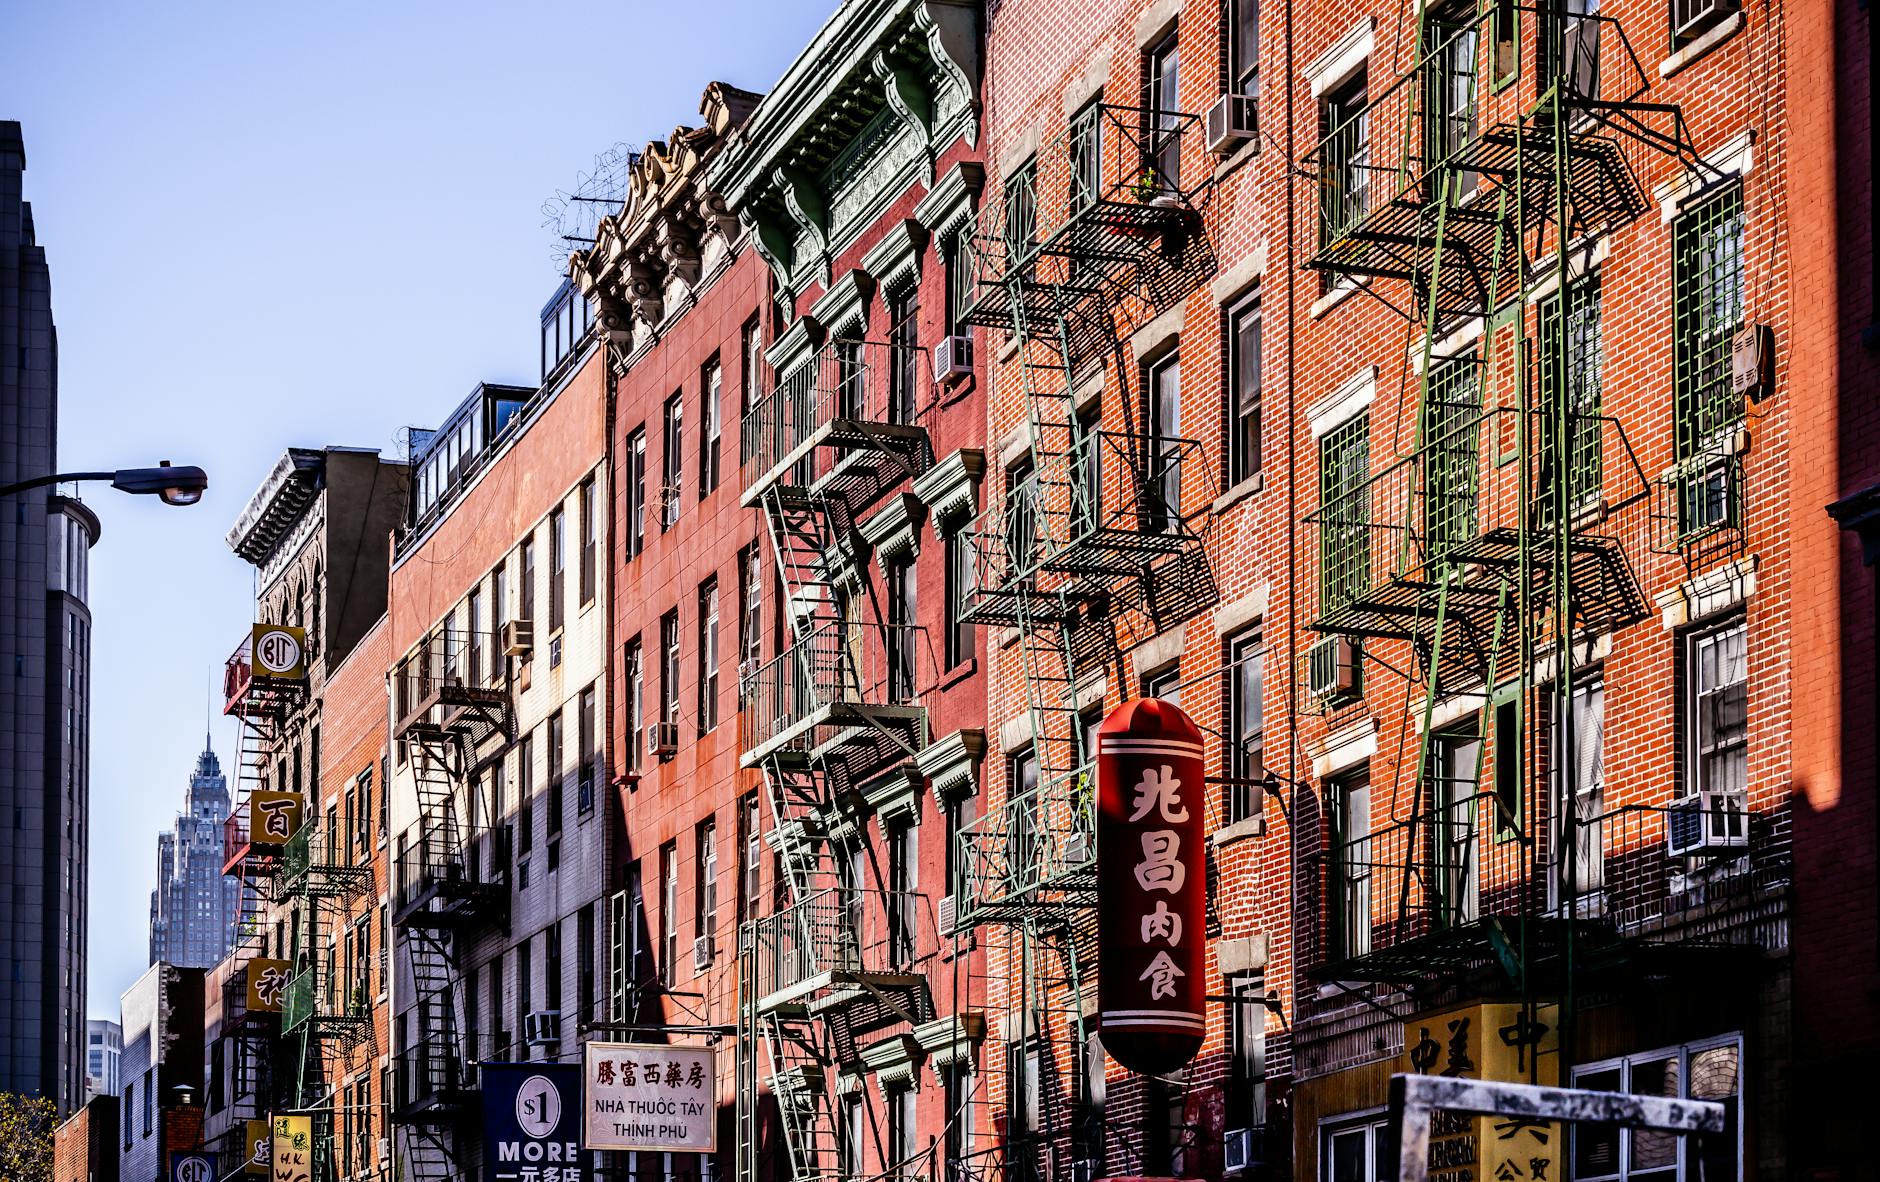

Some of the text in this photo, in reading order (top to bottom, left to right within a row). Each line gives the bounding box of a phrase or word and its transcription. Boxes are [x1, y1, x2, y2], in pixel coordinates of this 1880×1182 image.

[264, 636, 291, 667] BLT
[1128, 764, 1190, 1001] 兆昌肉食
[524, 1091, 551, 1124] $1
[280, 1152, 305, 1165] H.K.
[498, 1141, 578, 1162] MORE
